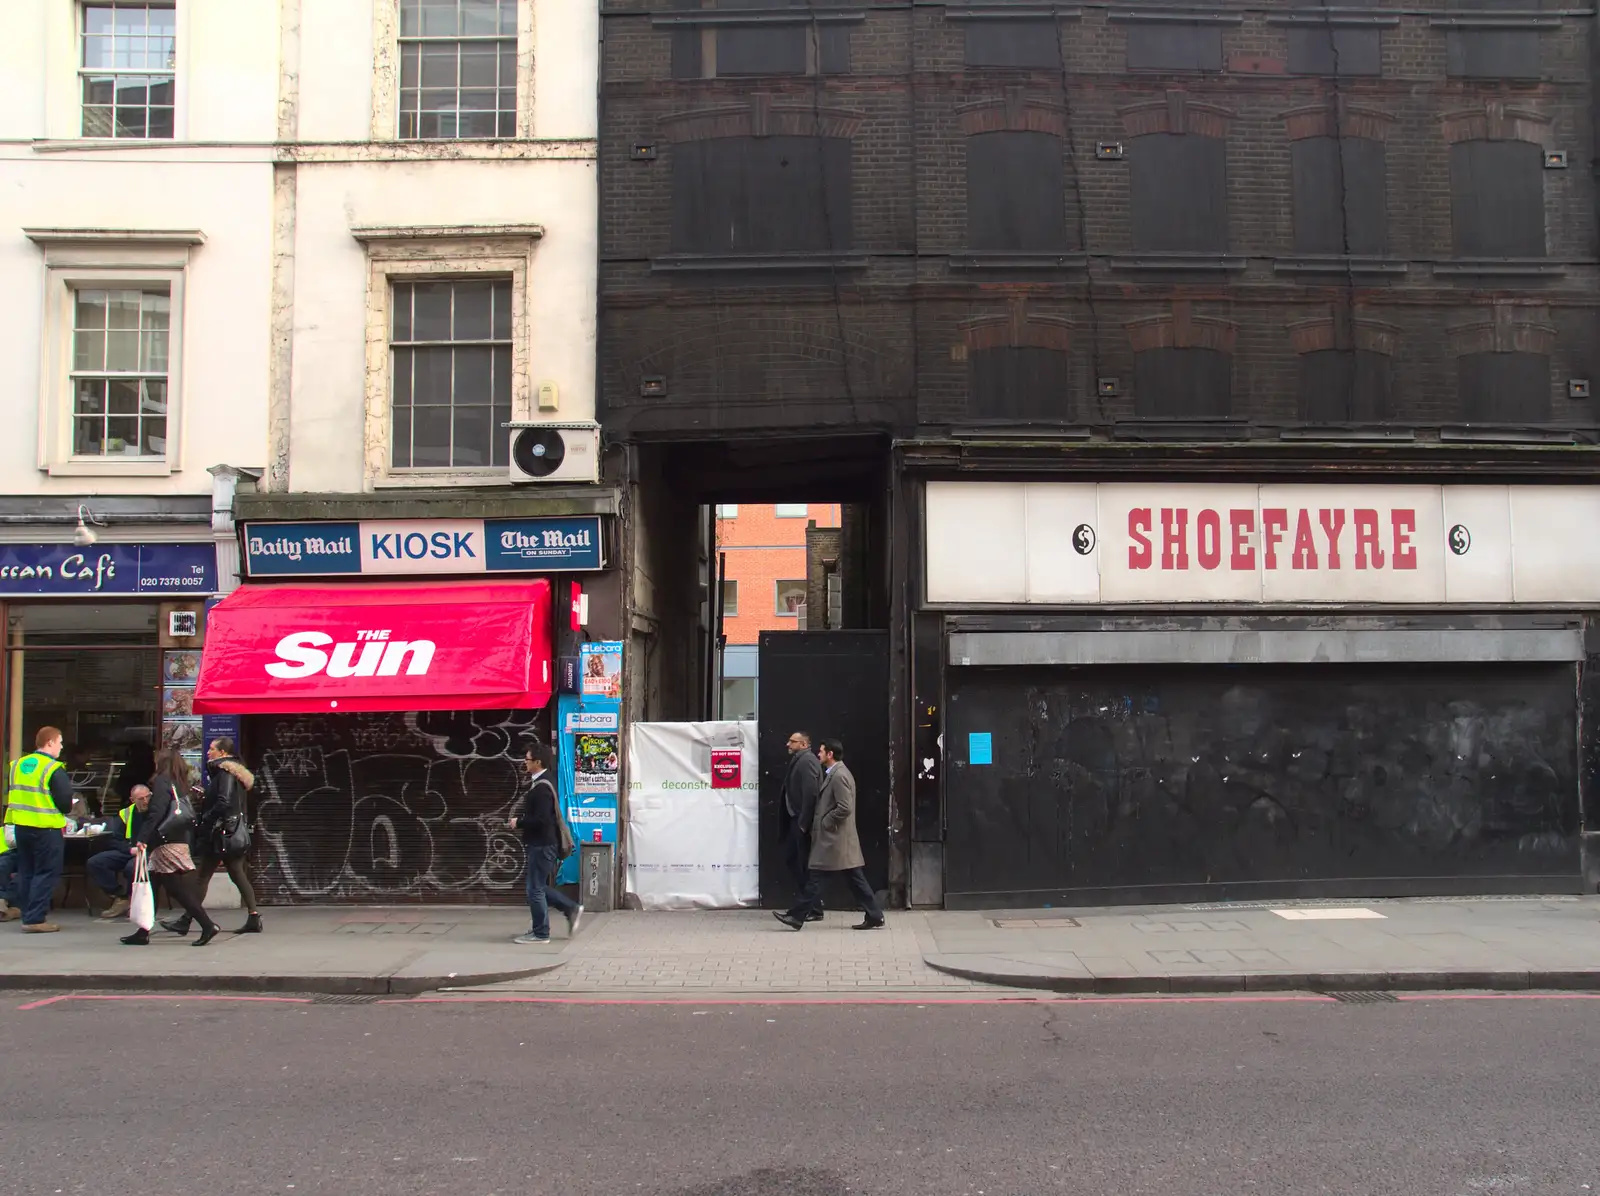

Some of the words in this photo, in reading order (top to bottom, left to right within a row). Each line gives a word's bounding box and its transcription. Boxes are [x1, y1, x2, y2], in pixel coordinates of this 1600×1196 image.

[500, 531, 540, 549] The
[541, 529, 591, 547] Mail
[1128, 508, 1417, 570] SHOEFAYRE
[249, 538, 302, 561] Daily
[303, 536, 353, 555] Mail
[371, 532, 477, 560] KIOSK
[191, 565, 204, 574] Tel
[141, 577, 158, 586] 020
[159, 577, 181, 586] 7378
[182, 577, 204, 586] 0057
[356, 629, 392, 641] THE
[590, 644, 621, 653] Lebara
[264, 631, 436, 679] Sun
[579, 714, 612, 722] Lebara
[578, 809, 611, 818] Lebara
